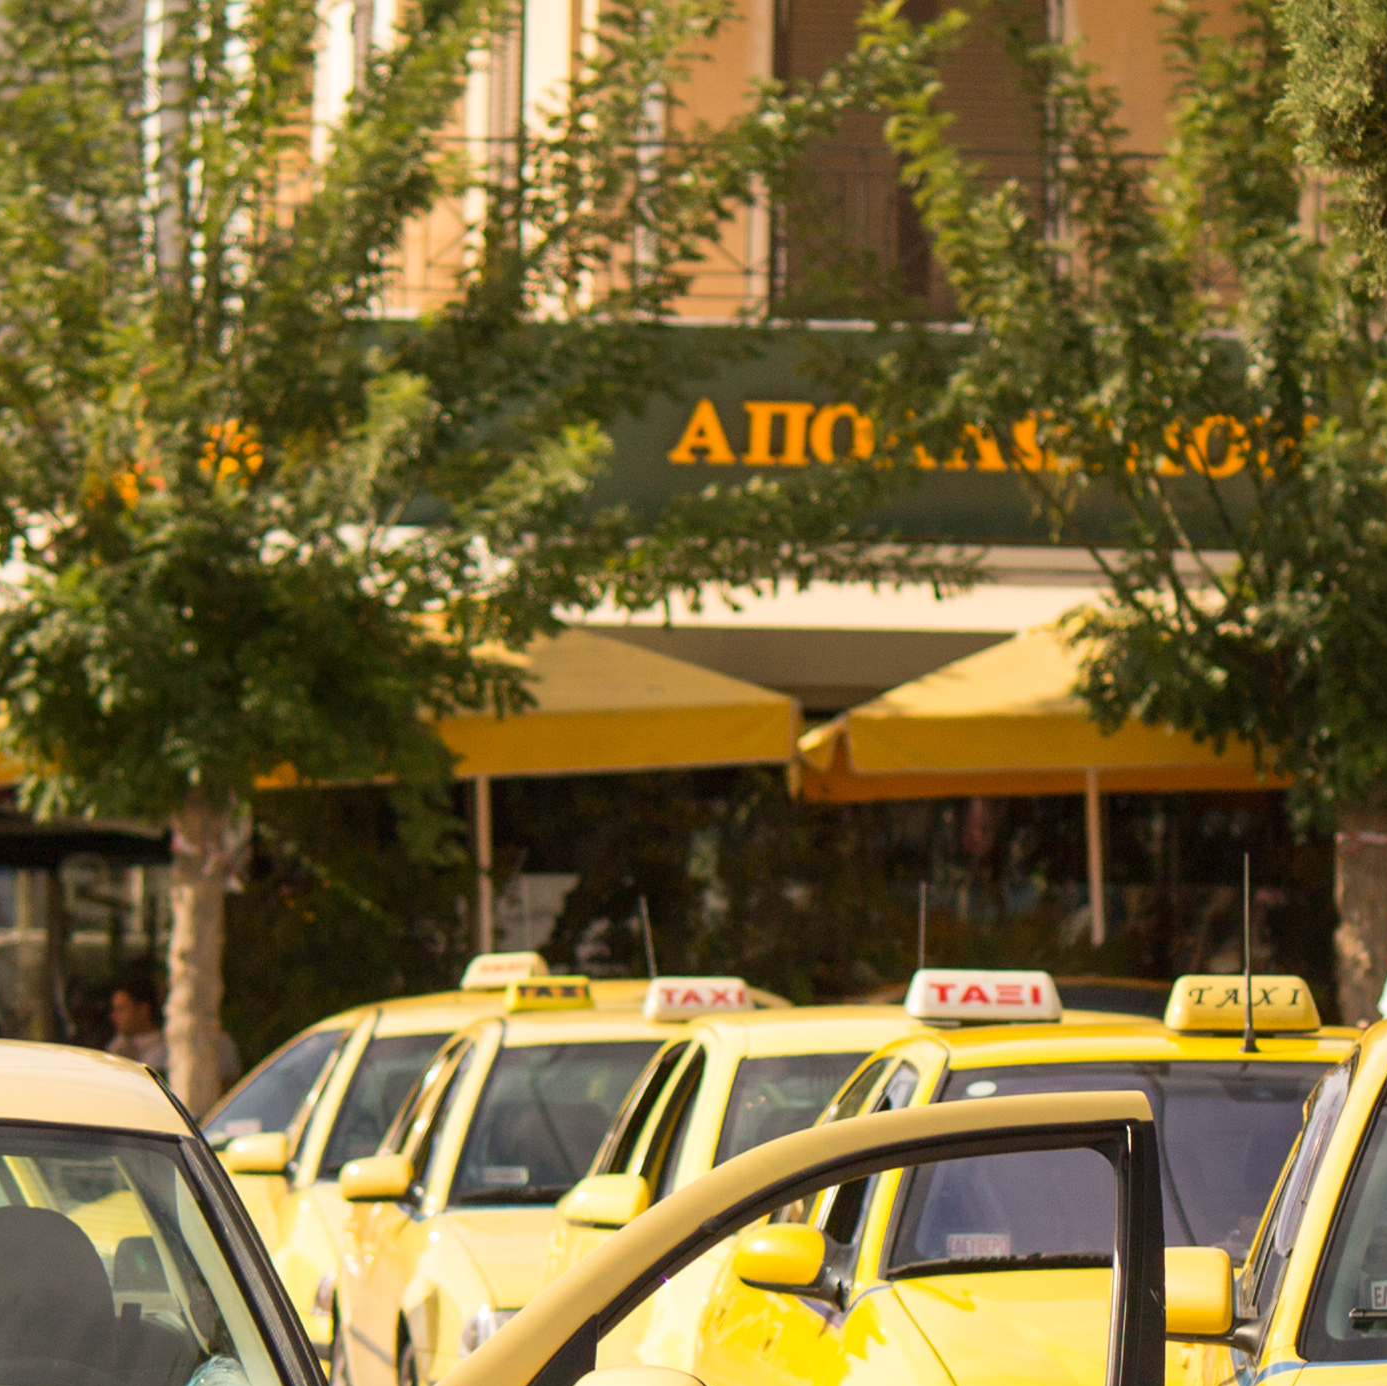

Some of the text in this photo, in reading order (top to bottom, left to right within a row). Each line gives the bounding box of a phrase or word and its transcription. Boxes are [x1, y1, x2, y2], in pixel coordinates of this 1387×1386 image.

[662, 988, 745, 1005] TAXI
[929, 983, 1042, 1005] ΤΑΞΙ
[1189, 987, 1302, 1008] TAXI
